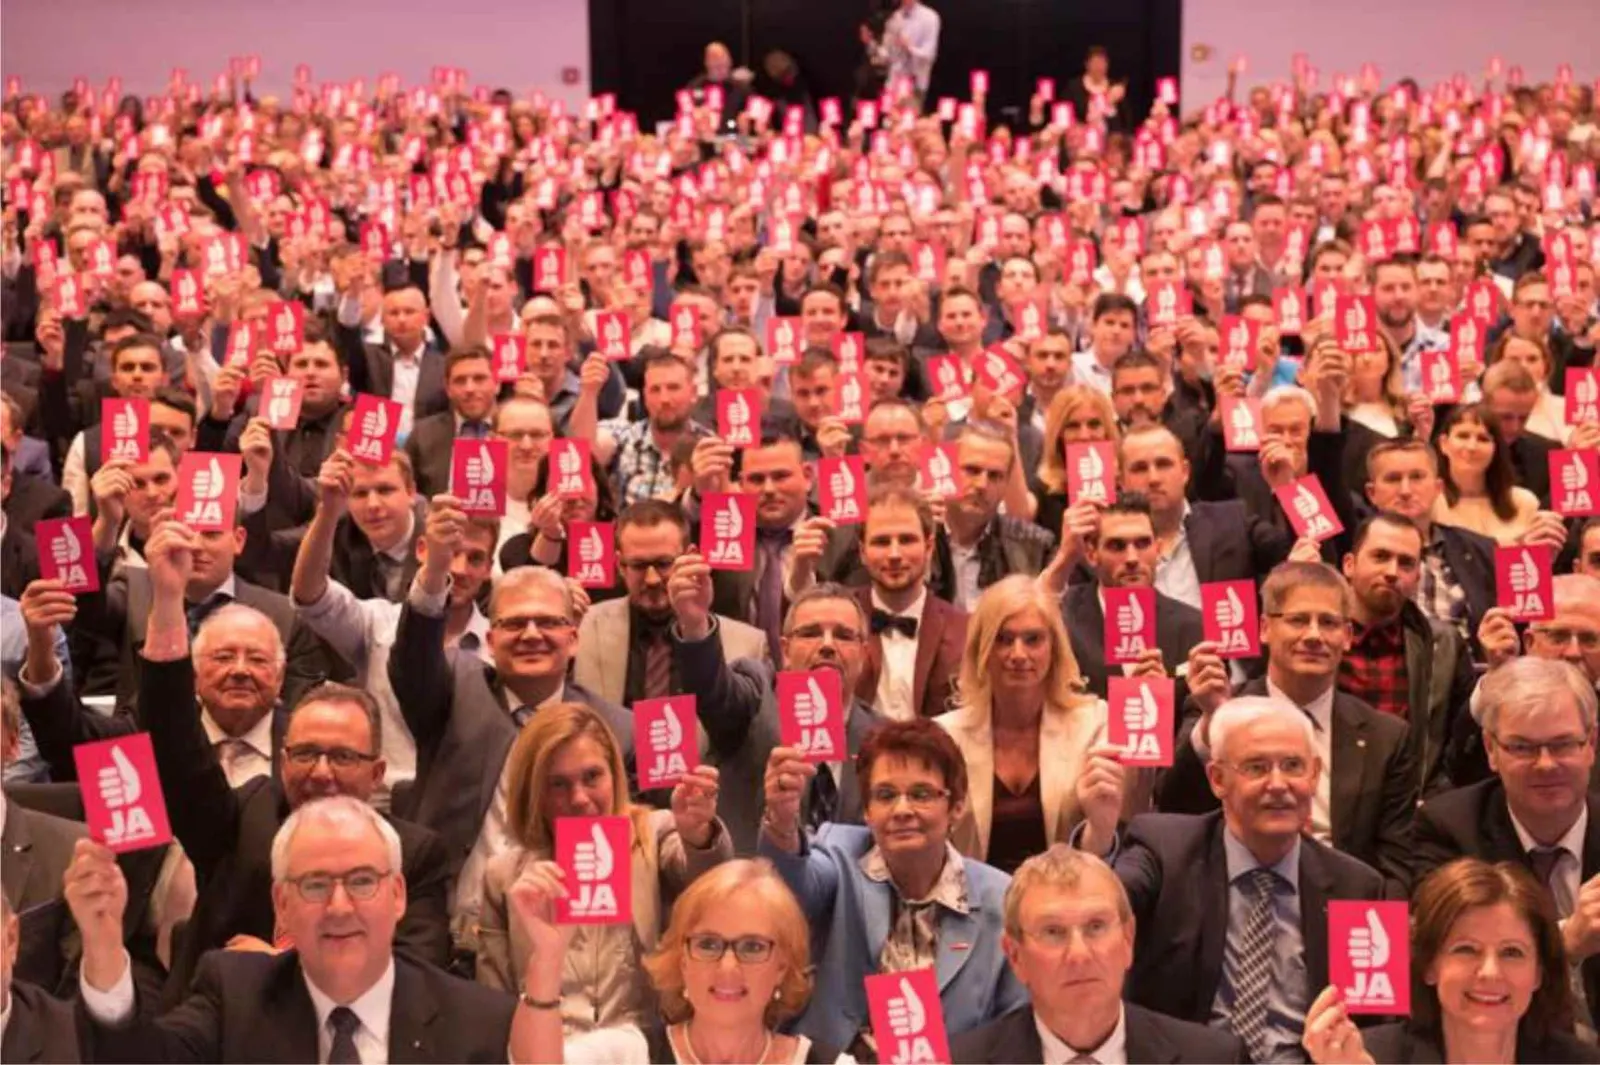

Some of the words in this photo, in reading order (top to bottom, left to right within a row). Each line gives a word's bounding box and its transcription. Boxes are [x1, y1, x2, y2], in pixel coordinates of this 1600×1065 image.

[1572, 404, 1599, 421] JA
[726, 426, 752, 442] JA
[1233, 428, 1259, 445] JA
[110, 439, 140, 457] JA
[353, 436, 383, 457] JA
[558, 474, 583, 491] JA
[1077, 479, 1106, 499] JA
[462, 490, 496, 507] JA
[830, 498, 859, 517] JA
[1563, 491, 1592, 509] JA
[185, 502, 222, 520] JA
[1305, 515, 1334, 536] JA
[710, 541, 742, 558] JA
[57, 567, 88, 586] JA
[577, 563, 604, 580] JA
[1508, 592, 1544, 612] JA
[1114, 635, 1146, 654] JA
[1216, 629, 1249, 648] JA
[793, 728, 833, 752] JA
[1119, 734, 1160, 755] JA
[649, 753, 688, 776] JA
[103, 806, 155, 840] JA
[569, 884, 617, 910] JA
[1344, 971, 1395, 997] JA
[891, 1036, 936, 1064] JA
